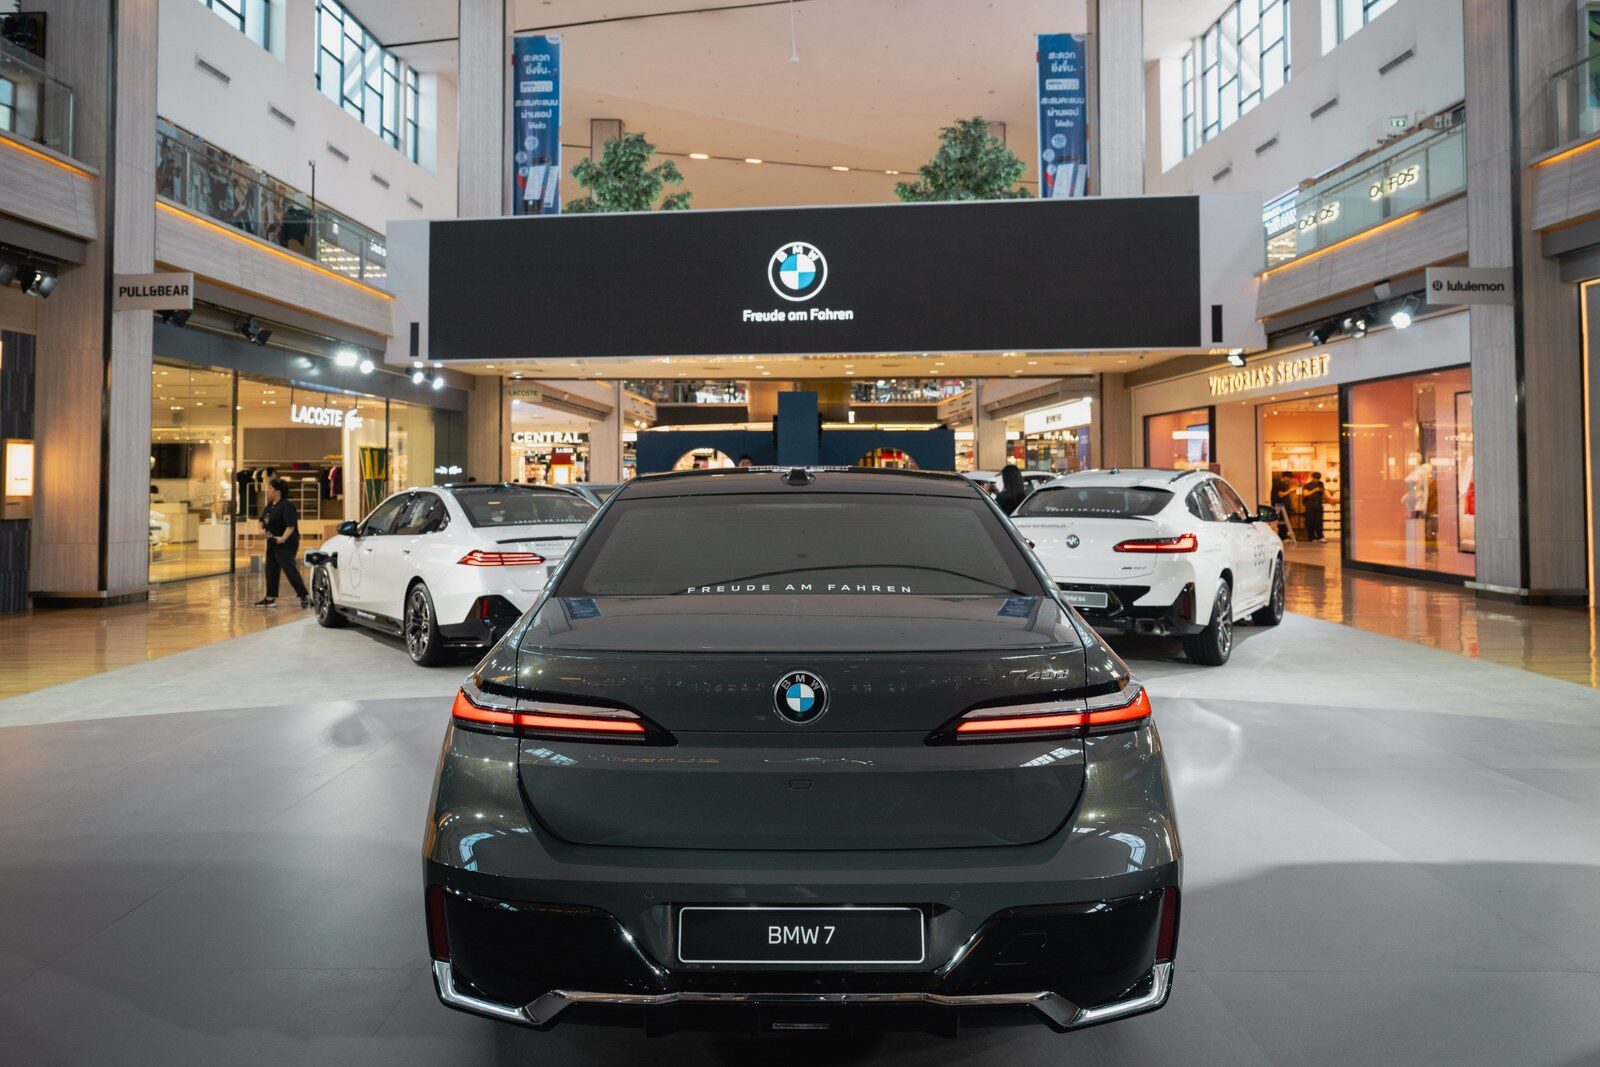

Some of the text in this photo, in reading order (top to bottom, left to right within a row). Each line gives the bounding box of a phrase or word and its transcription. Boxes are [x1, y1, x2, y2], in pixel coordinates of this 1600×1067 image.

[776, 245, 821, 263] BMW
[119, 285, 189, 297] PULL&BEAR
[1447, 281, 1505, 291] lululemon
[743, 308, 854, 322] Freude am Fahren
[1209, 355, 1330, 395] VICTORIA'S SECRET
[508, 389, 538, 397] LACOSTE
[290, 404, 344, 428] LACOSTE
[513, 431, 583, 443] CENTRAL
[687, 584, 770, 594] FREUDE
[828, 584, 912, 593] FAHREN
[780, 674, 821, 691] BMW
[768, 926, 836, 944] BMW 7
